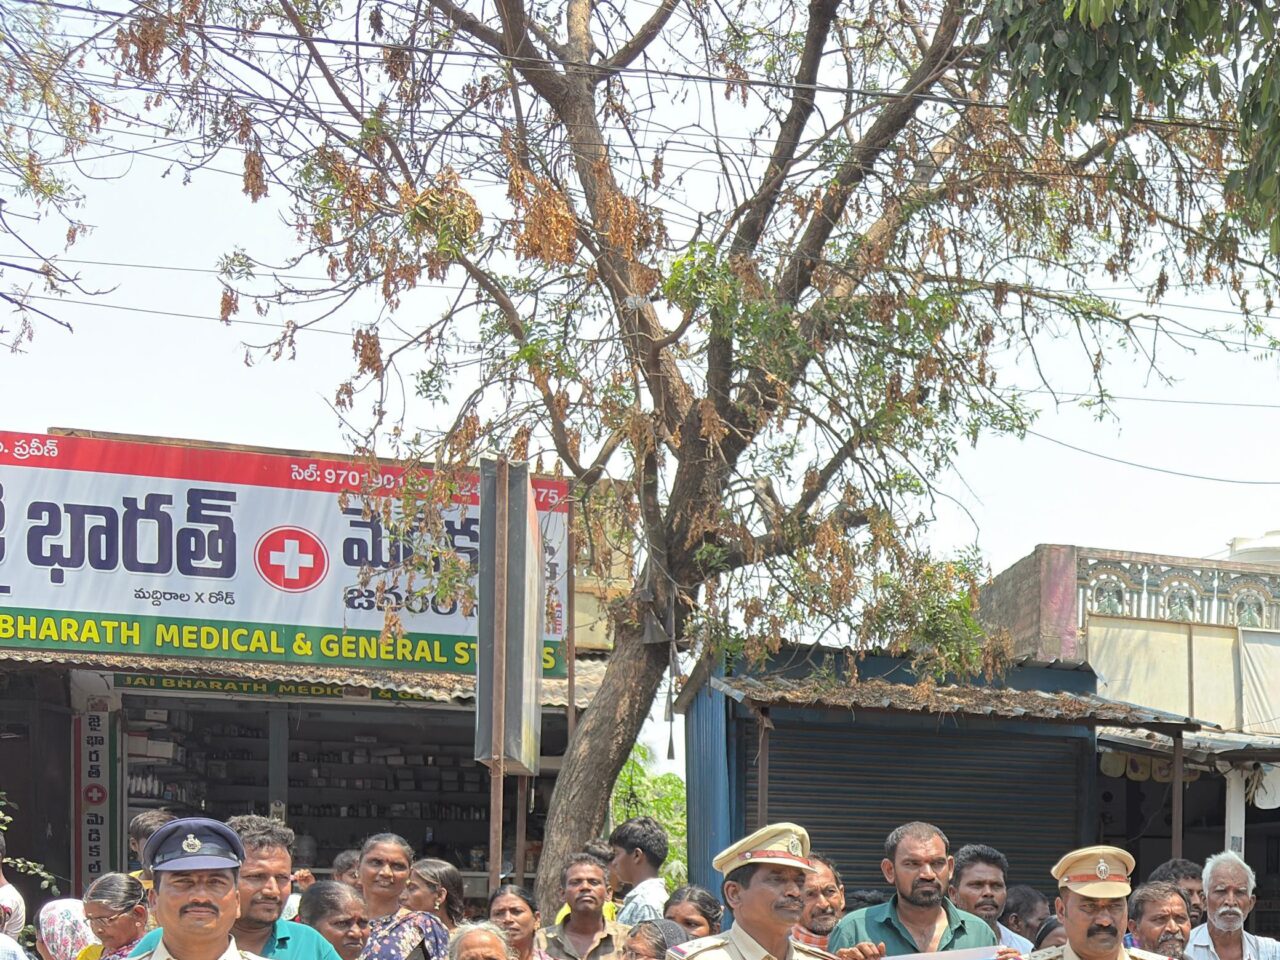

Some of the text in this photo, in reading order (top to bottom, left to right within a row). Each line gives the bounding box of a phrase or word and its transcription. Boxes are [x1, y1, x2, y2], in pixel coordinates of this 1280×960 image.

[27, 487, 238, 584] భారత్
[0, 614, 141, 645] BHARATH
[156, 624, 285, 655] MEDICAL
[292, 632, 313, 656] &
[320, 634, 447, 663] GENERAL
[123, 676, 345, 697] JAI BHARATH MEDIC
